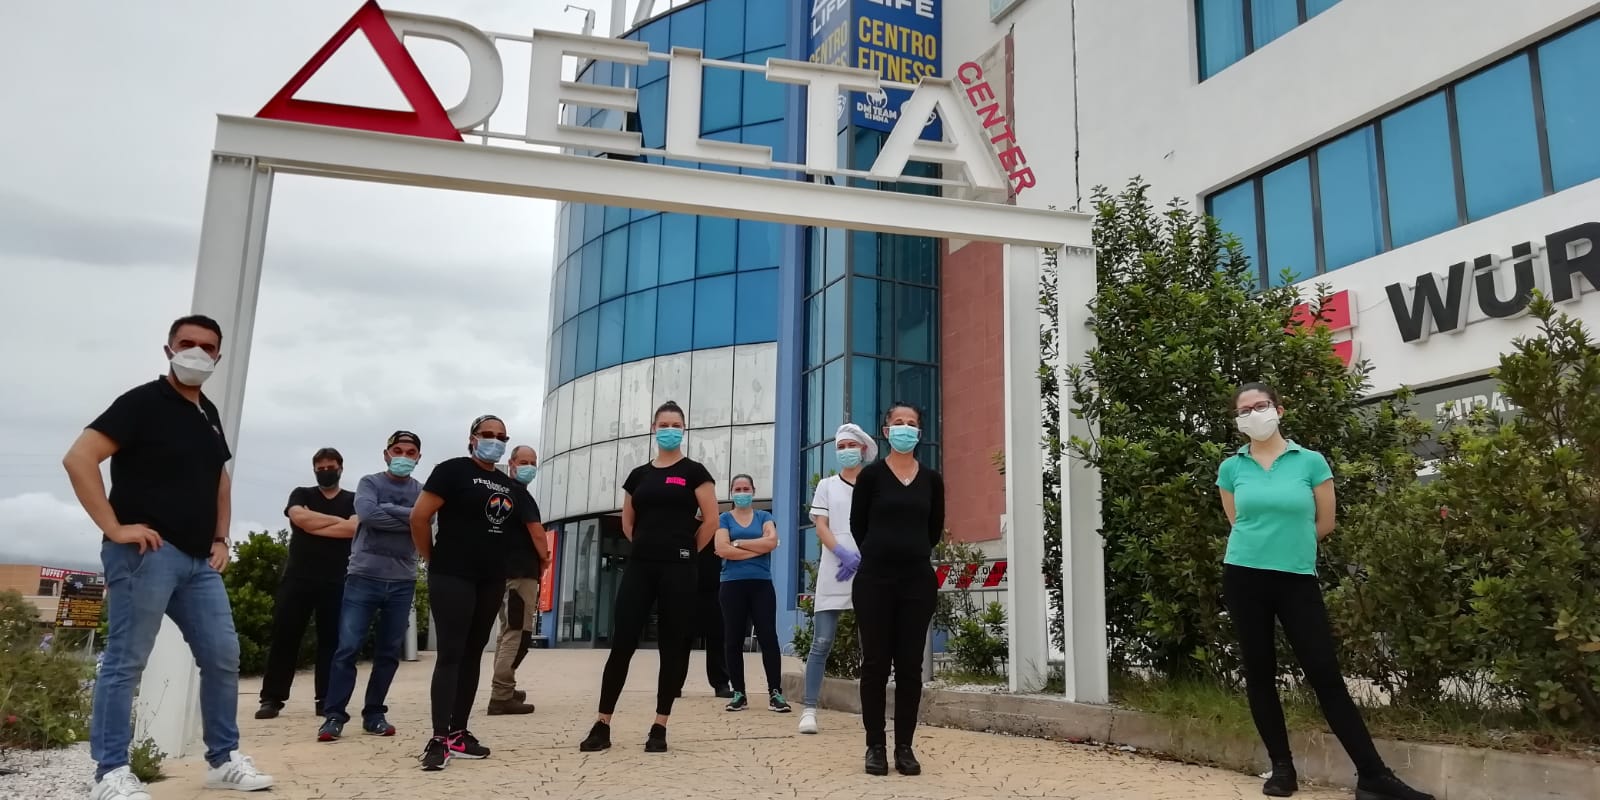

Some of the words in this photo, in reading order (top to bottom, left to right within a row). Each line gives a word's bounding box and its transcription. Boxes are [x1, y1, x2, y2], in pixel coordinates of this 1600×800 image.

[858, 16, 937, 60] CENTRO
[384, 9, 1008, 190] DELTA
[873, 106, 897, 119] TEAM
[957, 61, 1037, 195] CENTER
[1435, 391, 1524, 424] ENTRA
[41, 567, 64, 578] BUFFET
